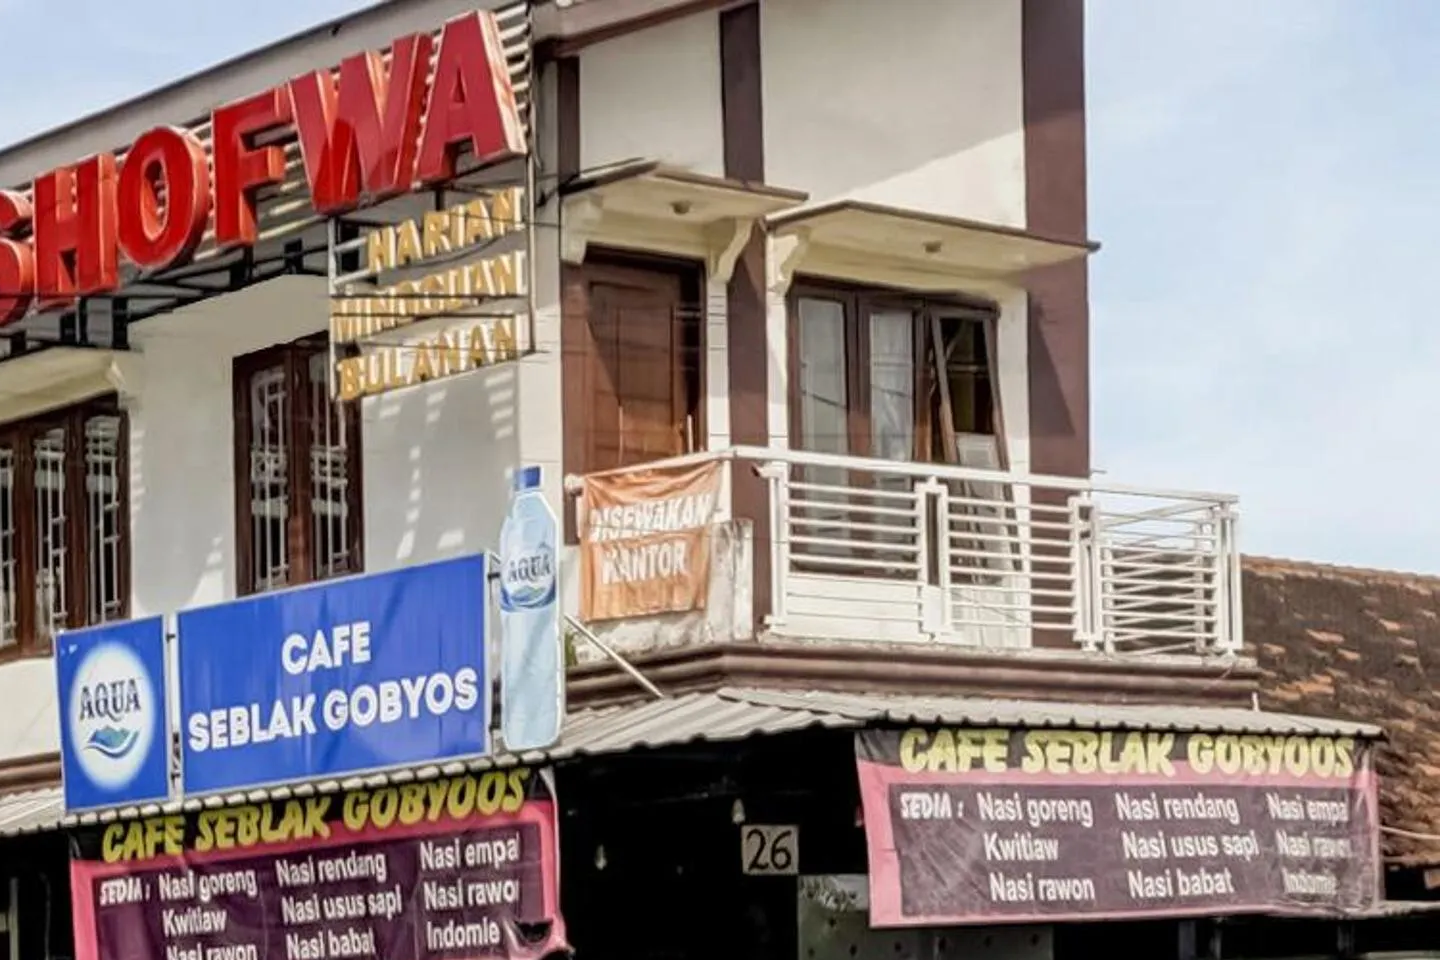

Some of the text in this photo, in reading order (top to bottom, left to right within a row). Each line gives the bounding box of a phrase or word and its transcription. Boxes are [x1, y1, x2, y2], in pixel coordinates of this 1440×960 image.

[368, 186, 526, 273] HARIAN
[336, 313, 527, 400] BULANAN
[507, 553, 554, 583] AQUA
[602, 541, 690, 585] KANTOR
[281, 621, 371, 675] CAFE
[79, 678, 142, 722] AQUA
[188, 667, 479, 752] SEBLAK GOBYOS
[900, 728, 1355, 777] CAFE SEBLAK GOBYOOS
[102, 767, 530, 863] CAFE SEBLAK GOBYOOS
[976, 791, 1023, 821] Nasi
[1027, 798, 1094, 827] goreng
[1115, 791, 1241, 825] Nasi rendang
[1266, 792, 1305, 820] Nasi
[420, 838, 461, 871] Nasi
[746, 828, 794, 872] 26
[983, 832, 1060, 861] Kwitiaw
[1121, 829, 1260, 861] Nasi usus sapi
[1275, 829, 1311, 856] Nasi
[159, 869, 196, 902] Nasi
[199, 868, 258, 902] goreng
[276, 850, 387, 888] Nasi rendang
[989, 871, 1096, 901] Nasi rawon
[1128, 867, 1236, 899] Nasi babat
[282, 884, 403, 925] Nasi usus sapi
[424, 878, 463, 911] Nasi
[163, 906, 228, 938] Kwitiaw
[426, 917, 501, 950] Indomie
